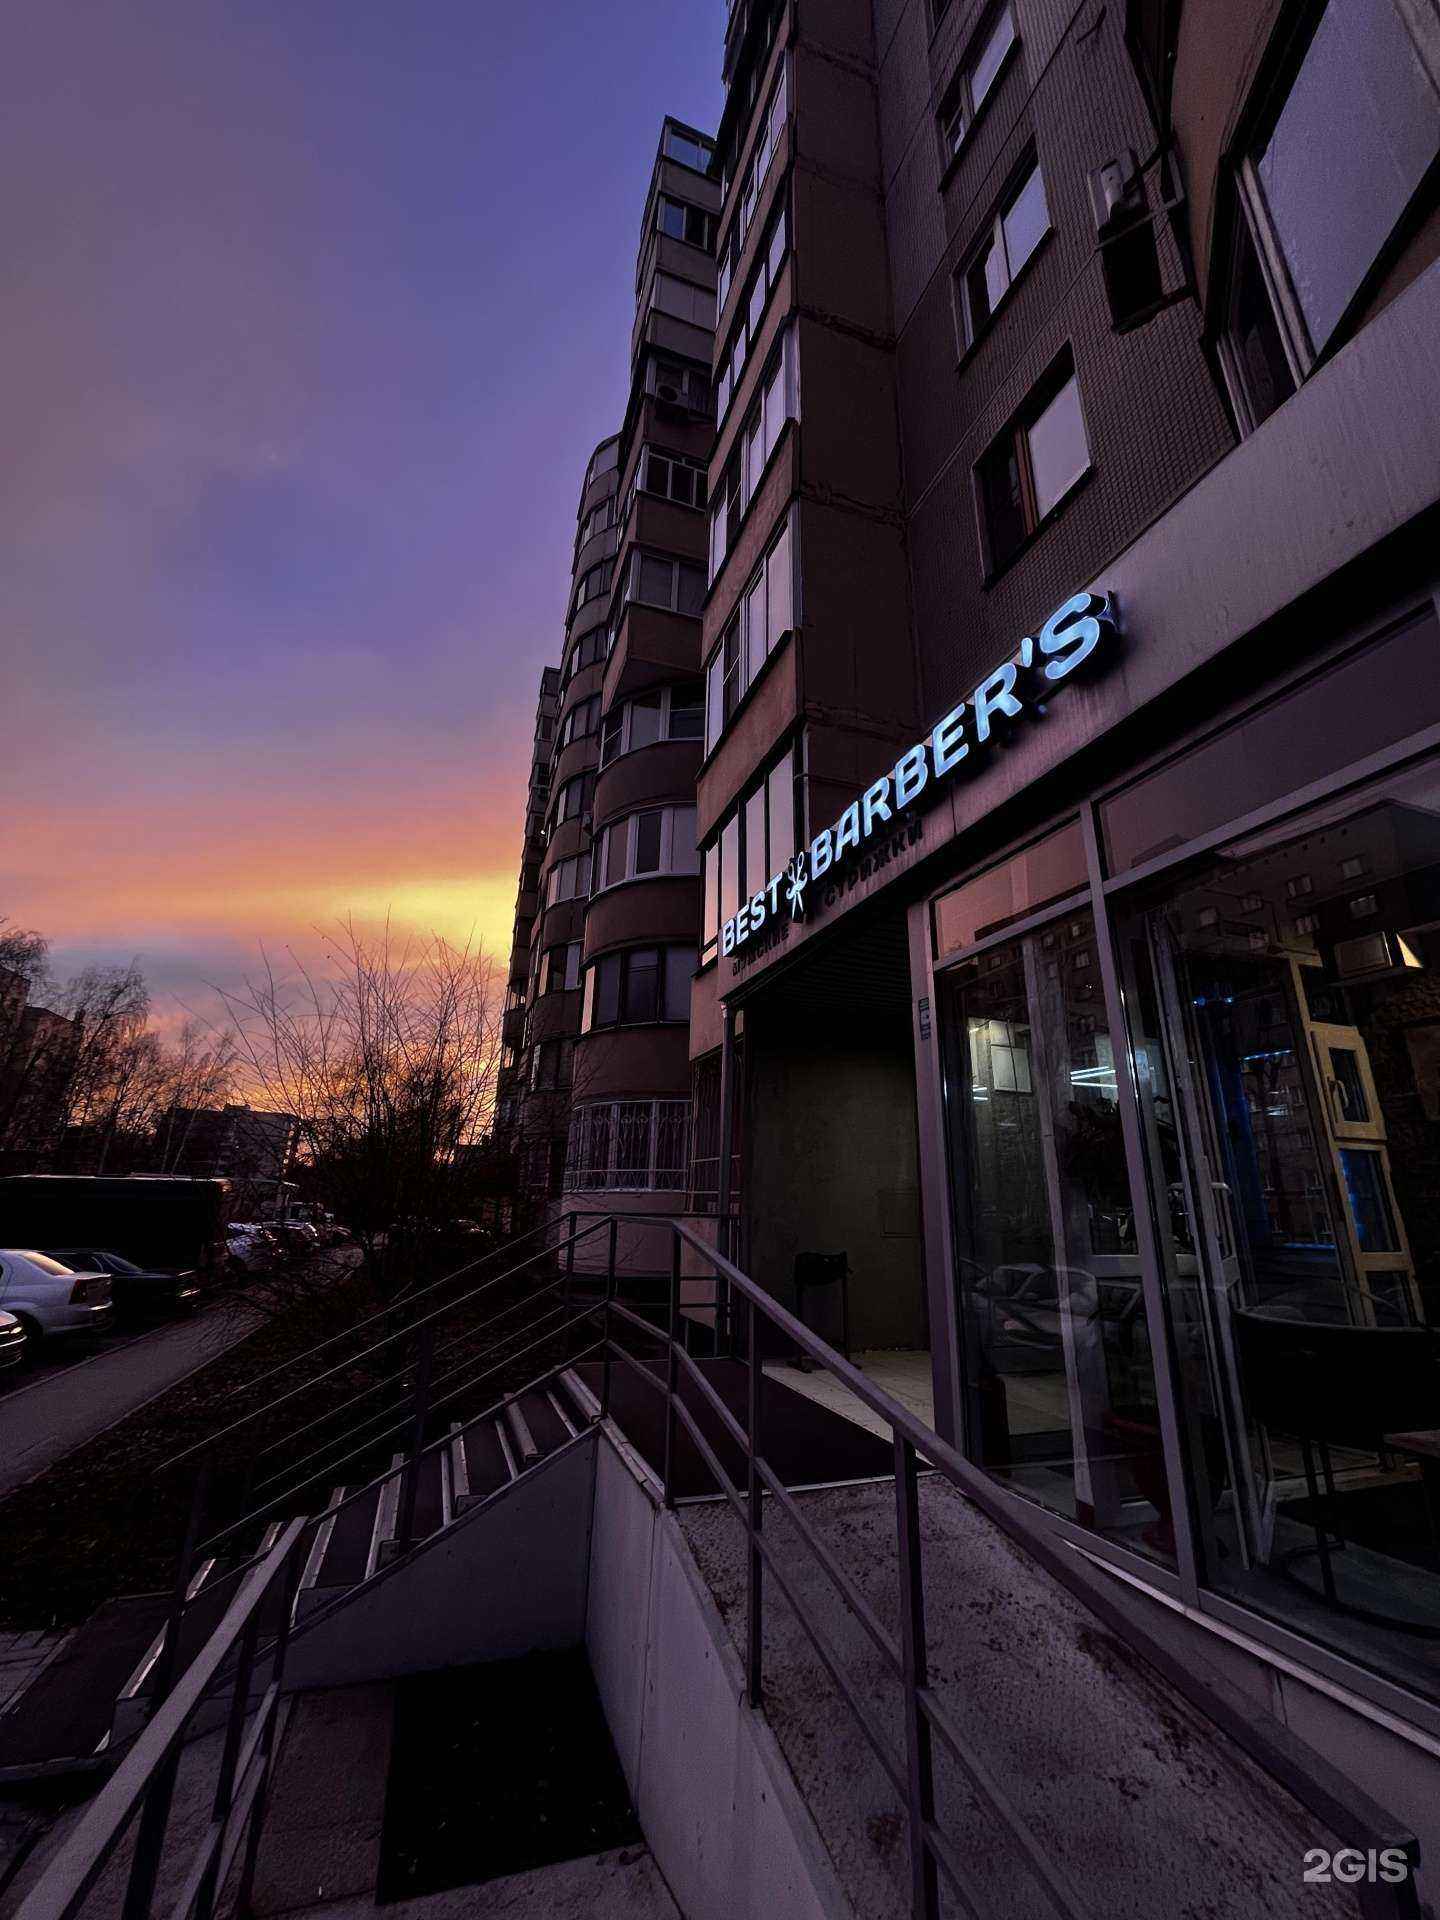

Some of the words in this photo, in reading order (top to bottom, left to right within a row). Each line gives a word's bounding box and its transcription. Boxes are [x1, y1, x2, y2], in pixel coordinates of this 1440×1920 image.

[722, 871, 783, 957] BEST
[810, 592, 1100, 881] BARBER'S
[824, 819, 923, 907] СТРИЖКИ
